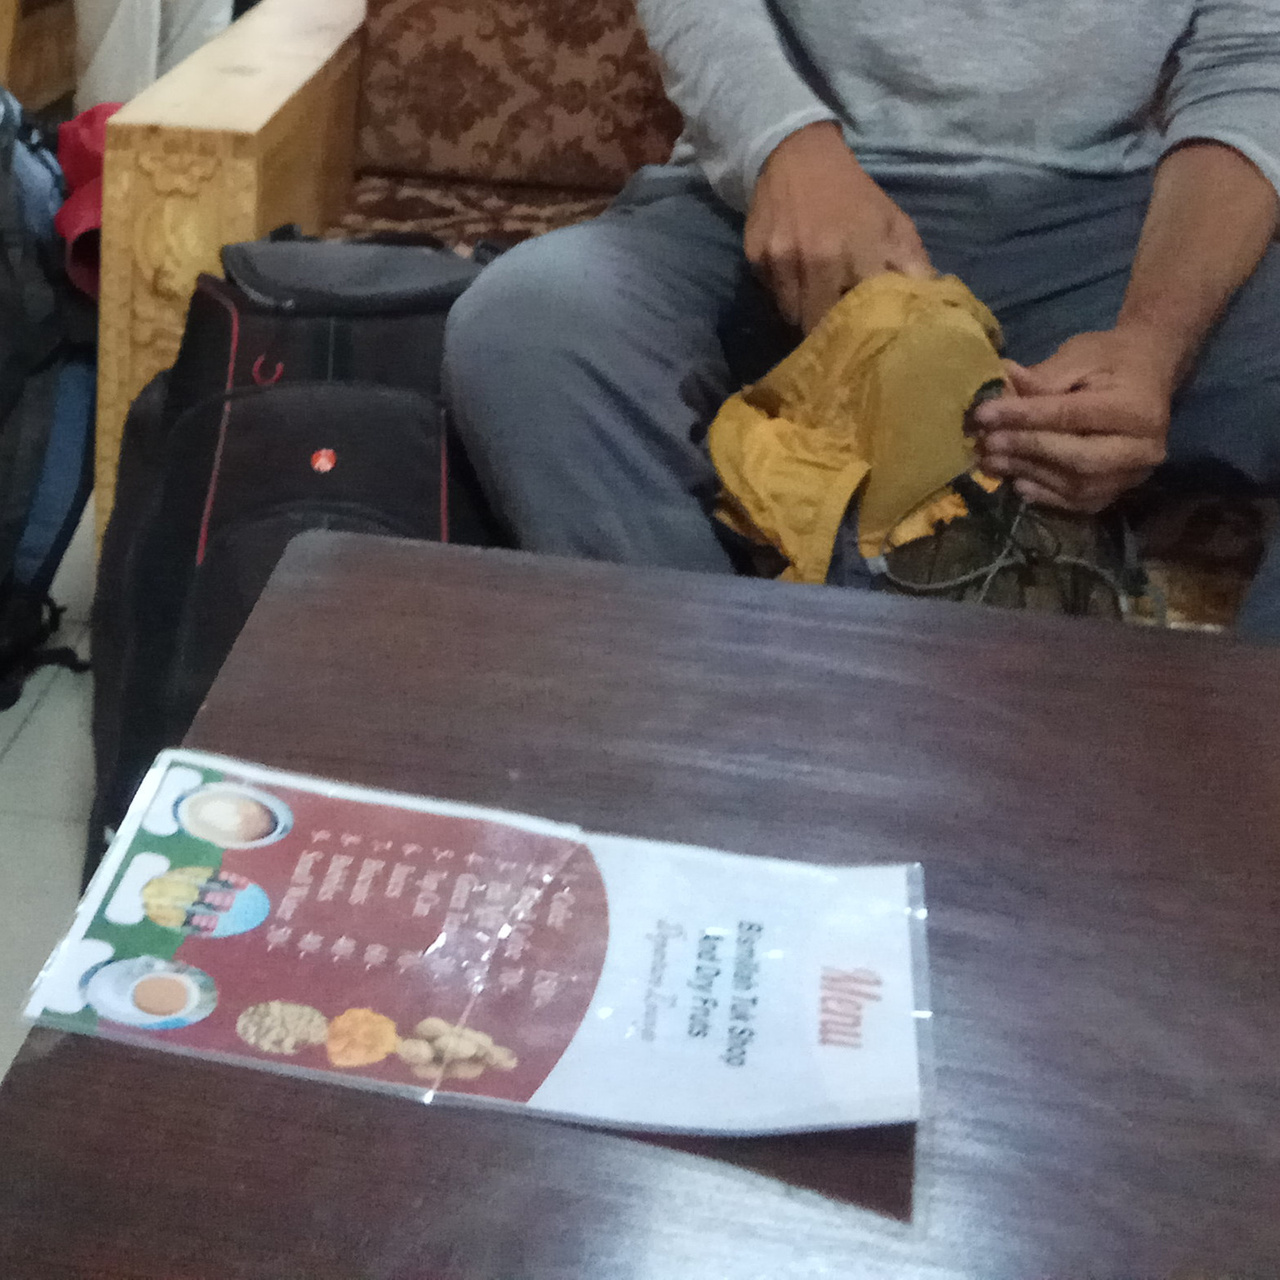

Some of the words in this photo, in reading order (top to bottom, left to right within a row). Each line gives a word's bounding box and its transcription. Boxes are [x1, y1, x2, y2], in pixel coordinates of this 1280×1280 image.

[731, 919, 764, 991] Bismillah
[687, 964, 721, 994] Dry
[729, 995, 759, 1022] Tuk
[819, 966, 882, 1048] Menu
[720, 1025, 756, 1067] Shop
